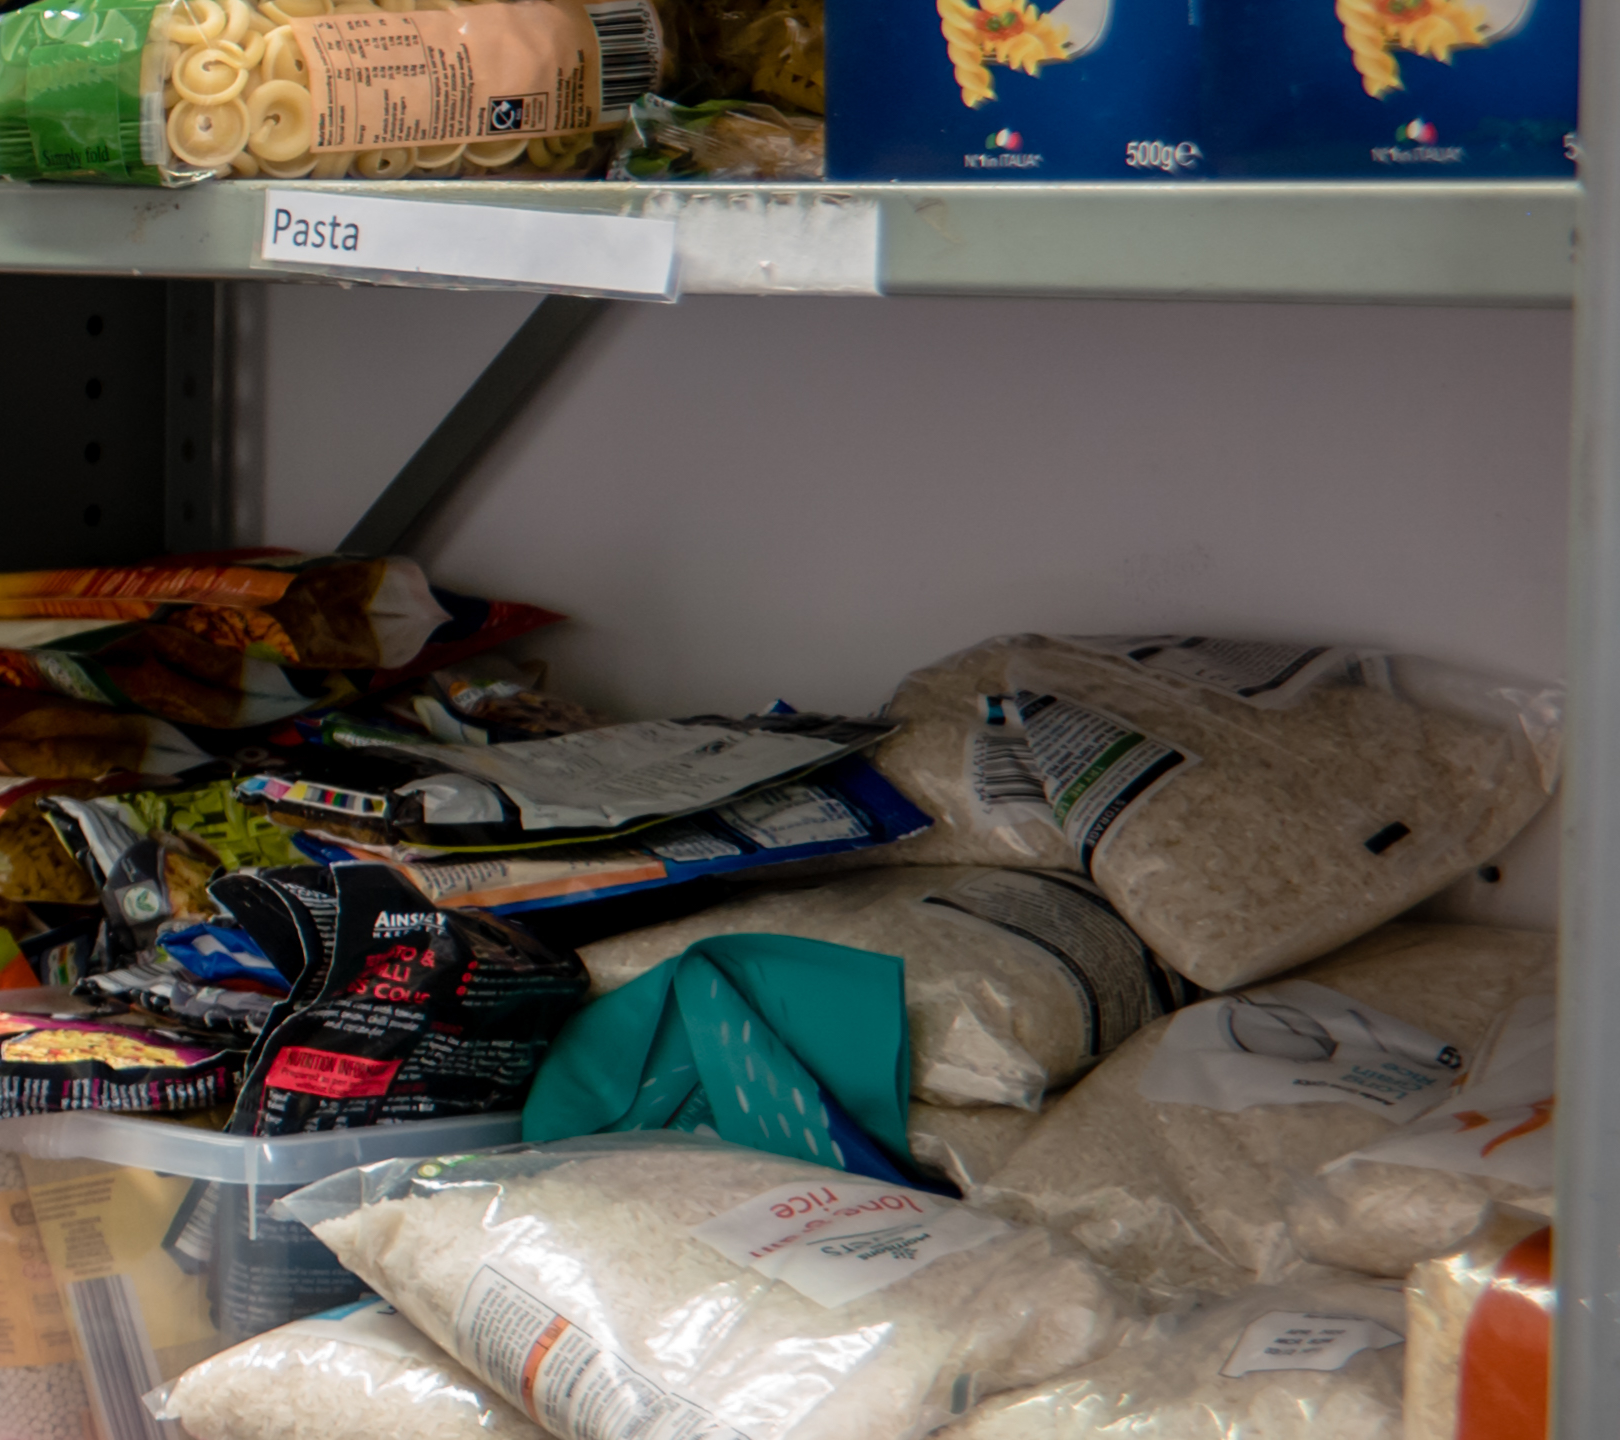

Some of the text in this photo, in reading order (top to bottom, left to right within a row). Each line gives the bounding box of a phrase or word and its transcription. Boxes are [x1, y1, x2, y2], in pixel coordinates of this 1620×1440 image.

[1125, 141, 1174, 170] 500g
[272, 207, 360, 256] Pasta
[769, 1187, 838, 1219] rice
